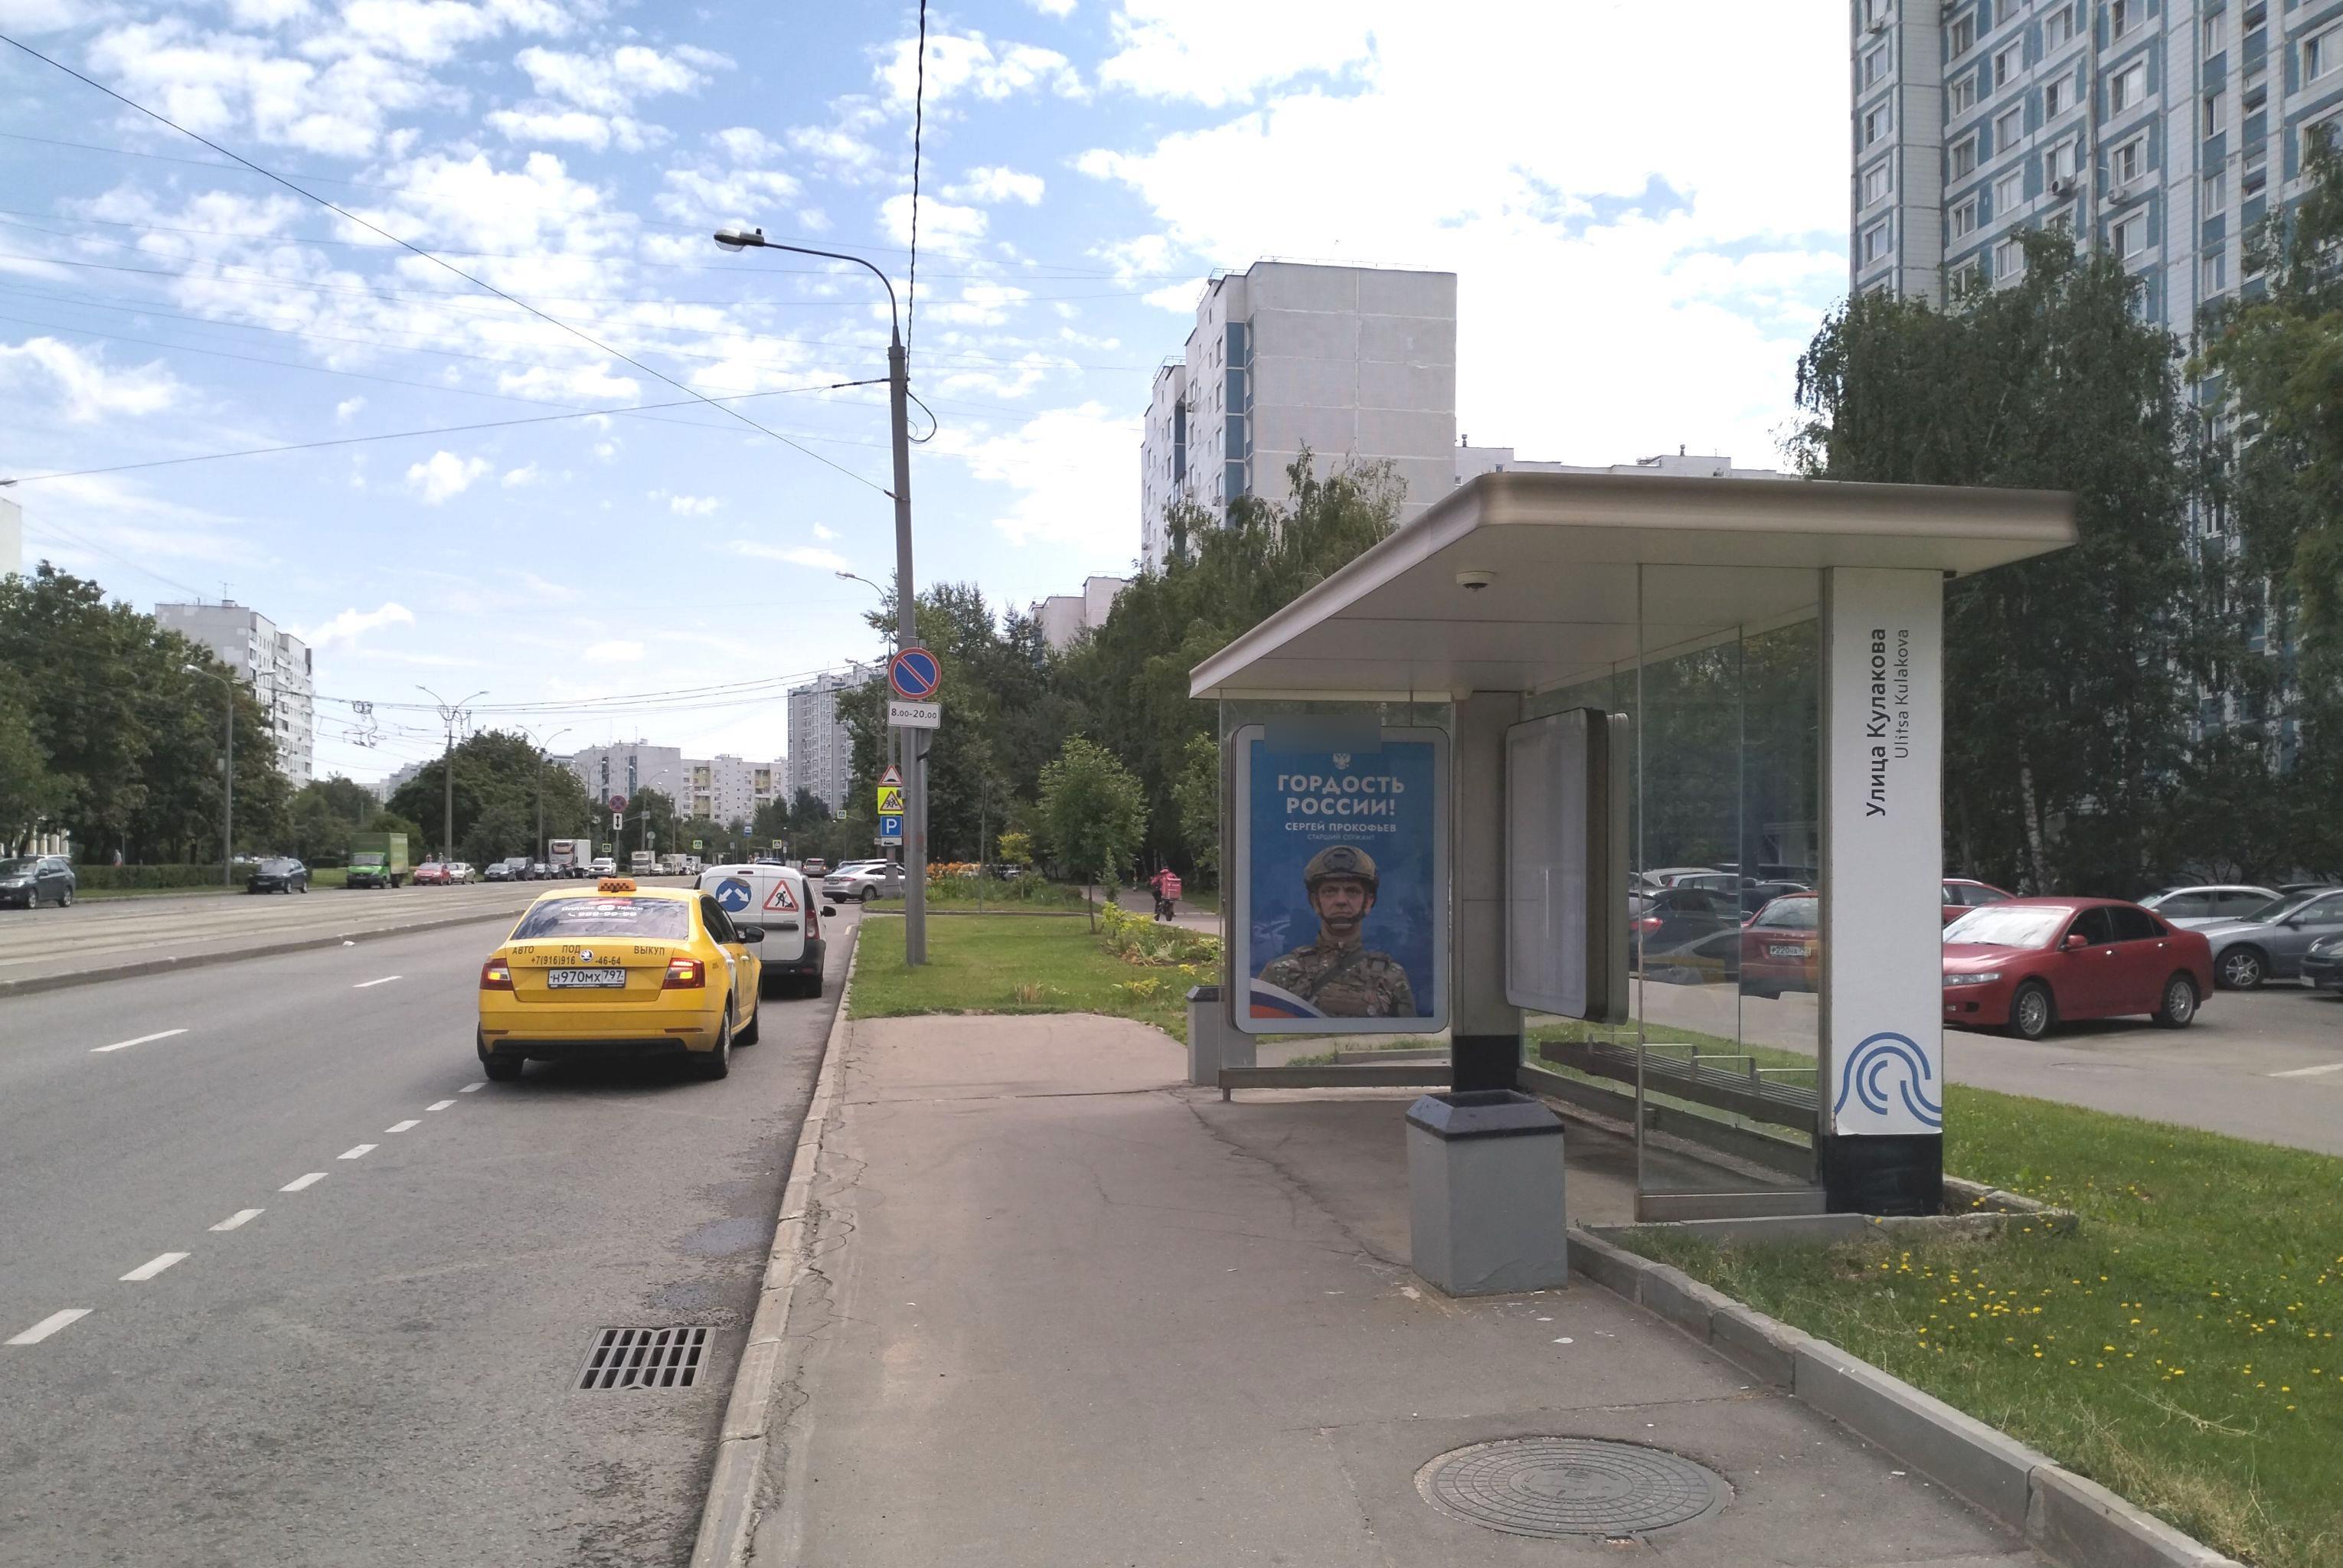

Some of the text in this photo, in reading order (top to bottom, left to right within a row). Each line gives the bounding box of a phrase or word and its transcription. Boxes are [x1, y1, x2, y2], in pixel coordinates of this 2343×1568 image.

[1894, 629, 1909, 759] Ulitsa Kulakova
[890, 707, 937, 720] 8.00-20.00
[1866, 629, 1890, 817] Улица Кулакова
[1278, 774, 1405, 795] ГОРДОСТЬ
[1286, 797, 1396, 817] РОССИИ!
[1285, 821, 1397, 832] СЕРГЕЙ ПРОКОФЬЕВ
[512, 945, 665, 956] АВТО ПОД ВЫКУП
